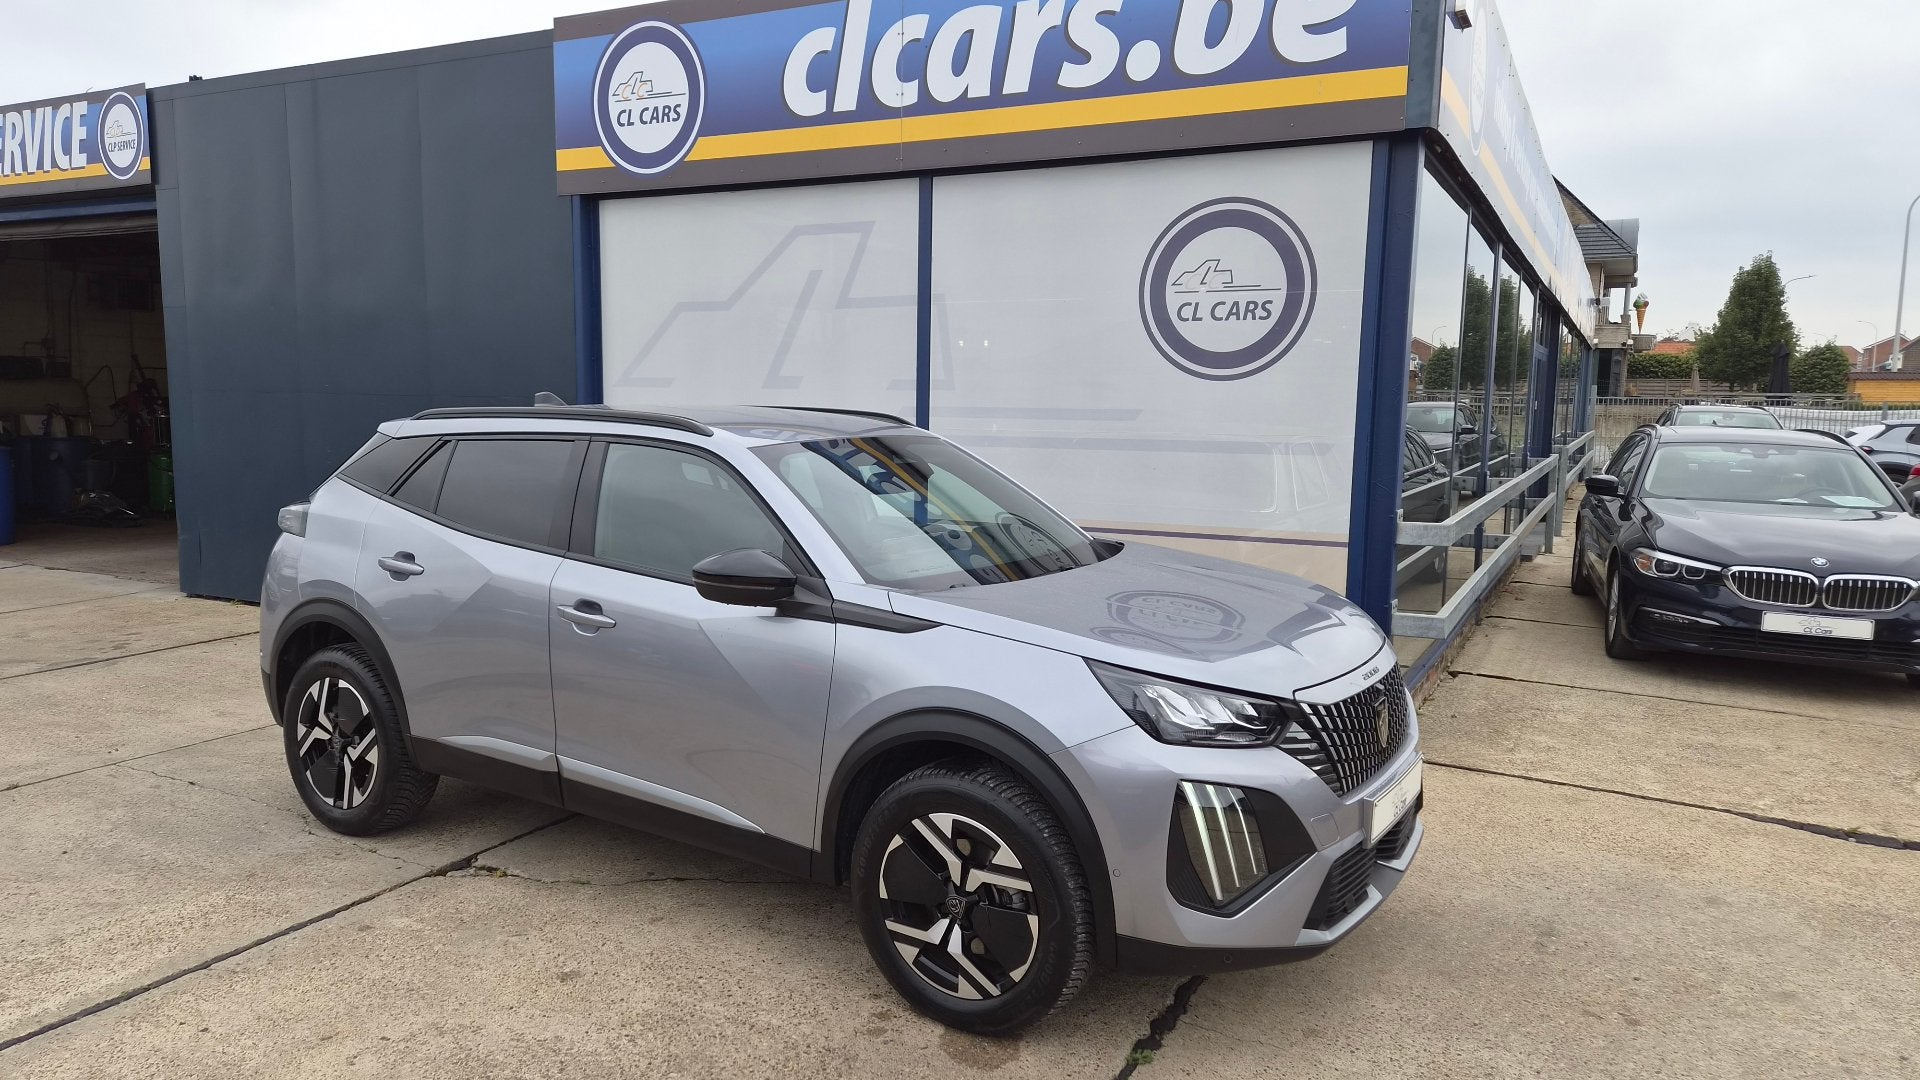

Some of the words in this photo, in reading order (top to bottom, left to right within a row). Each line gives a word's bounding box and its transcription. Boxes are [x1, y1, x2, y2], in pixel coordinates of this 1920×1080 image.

[617, 109, 635, 127] CL
[640, 104, 681, 125] CARS
[0, 101, 87, 176] RVICE
[117, 139, 136, 151] SERVICE
[1177, 302, 1203, 322] CL
[1210, 300, 1274, 321] CARS
